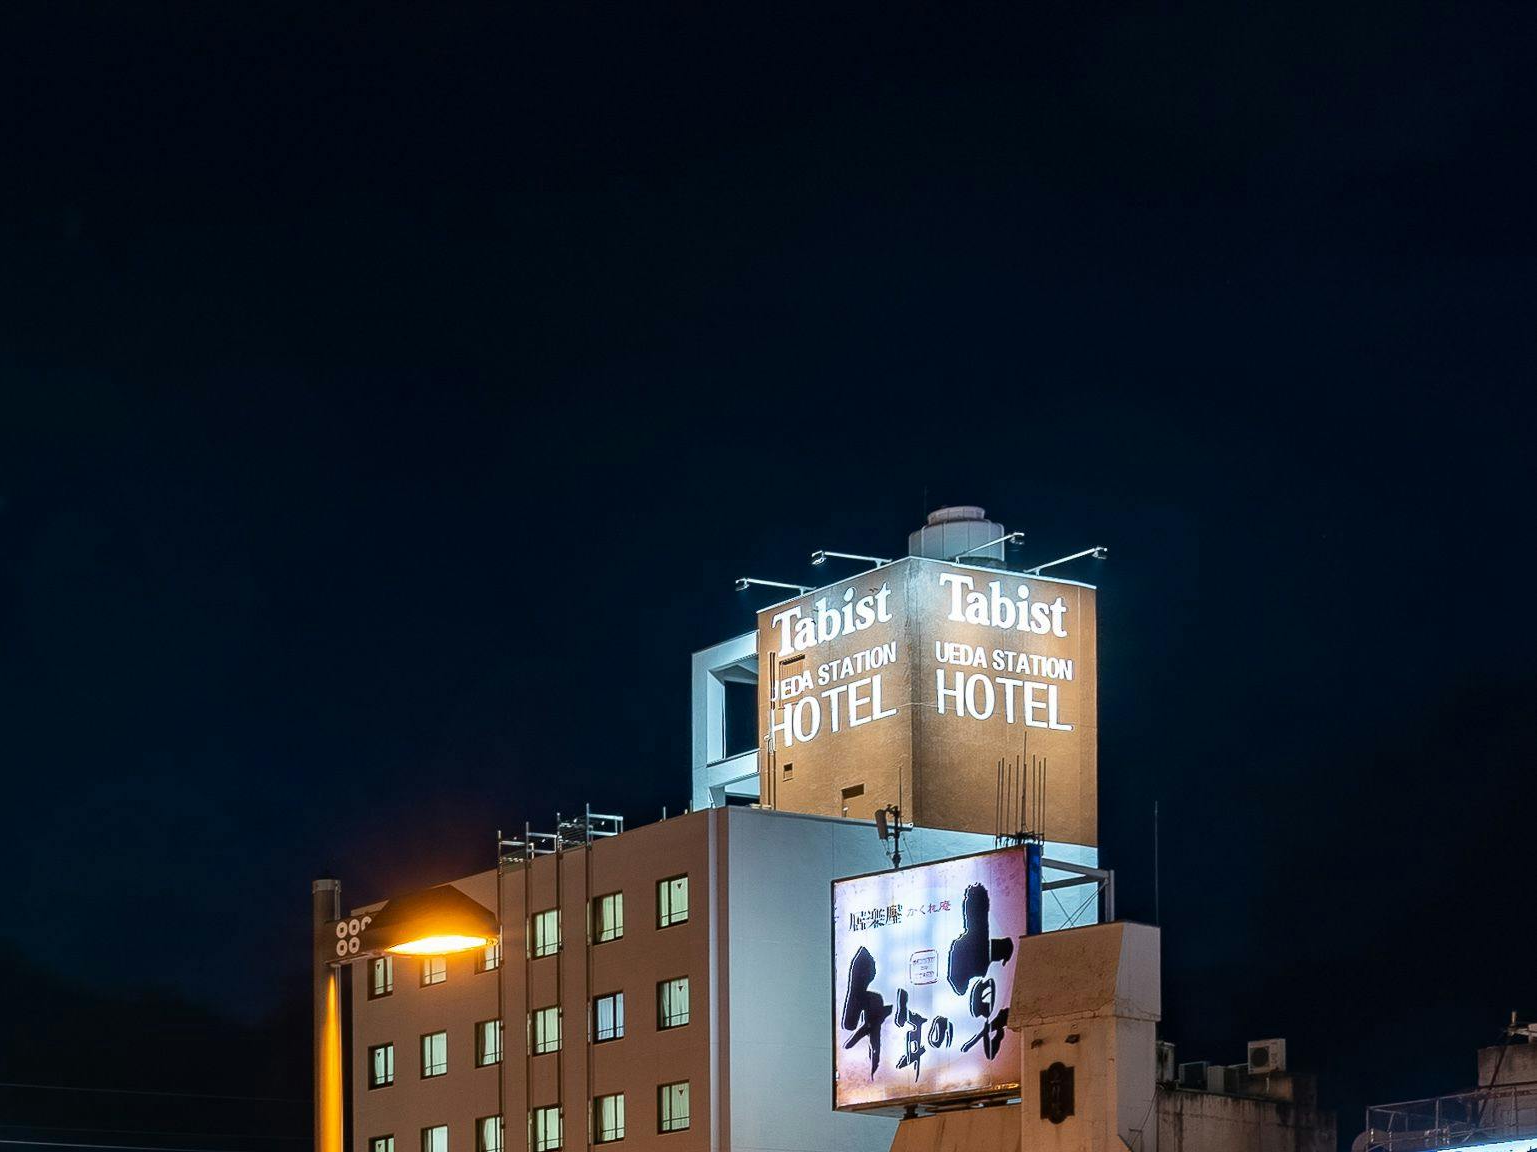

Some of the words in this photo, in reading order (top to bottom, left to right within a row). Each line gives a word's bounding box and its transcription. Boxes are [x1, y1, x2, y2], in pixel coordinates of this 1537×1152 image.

[771, 582, 893, 657] Tabist
[939, 572, 1068, 638] Tabist
[817, 641, 897, 687] STATION
[935, 640, 989, 670] UEDA
[992, 648, 1074, 681] STATION
[768, 675, 898, 748] HOTEL
[935, 669, 1074, 731] HOTEL
